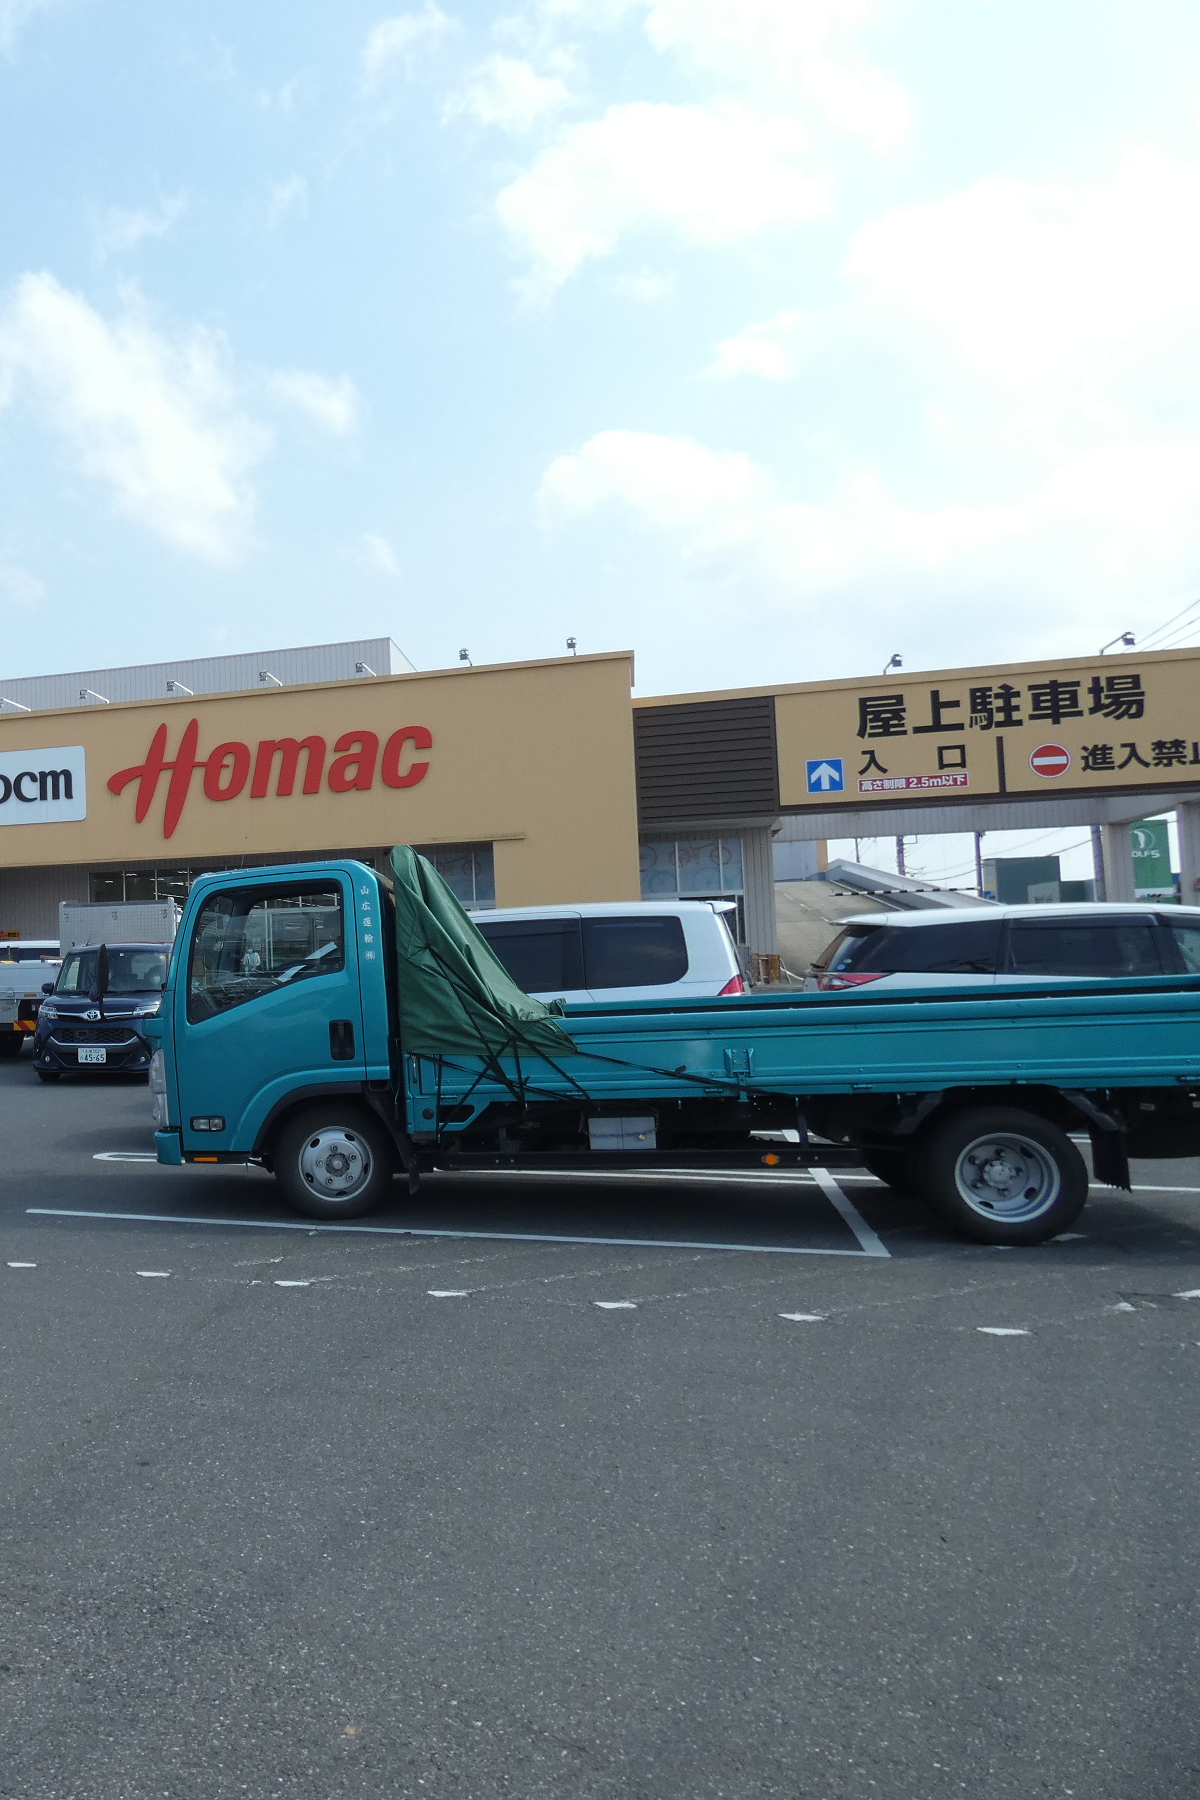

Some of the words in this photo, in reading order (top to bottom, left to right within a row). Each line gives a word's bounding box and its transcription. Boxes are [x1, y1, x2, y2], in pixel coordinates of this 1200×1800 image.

[856, 673, 1146, 739] 屋上駐車場
[106, 717, 433, 840] Homac
[84, 1053, 105, 1062] 45-65
